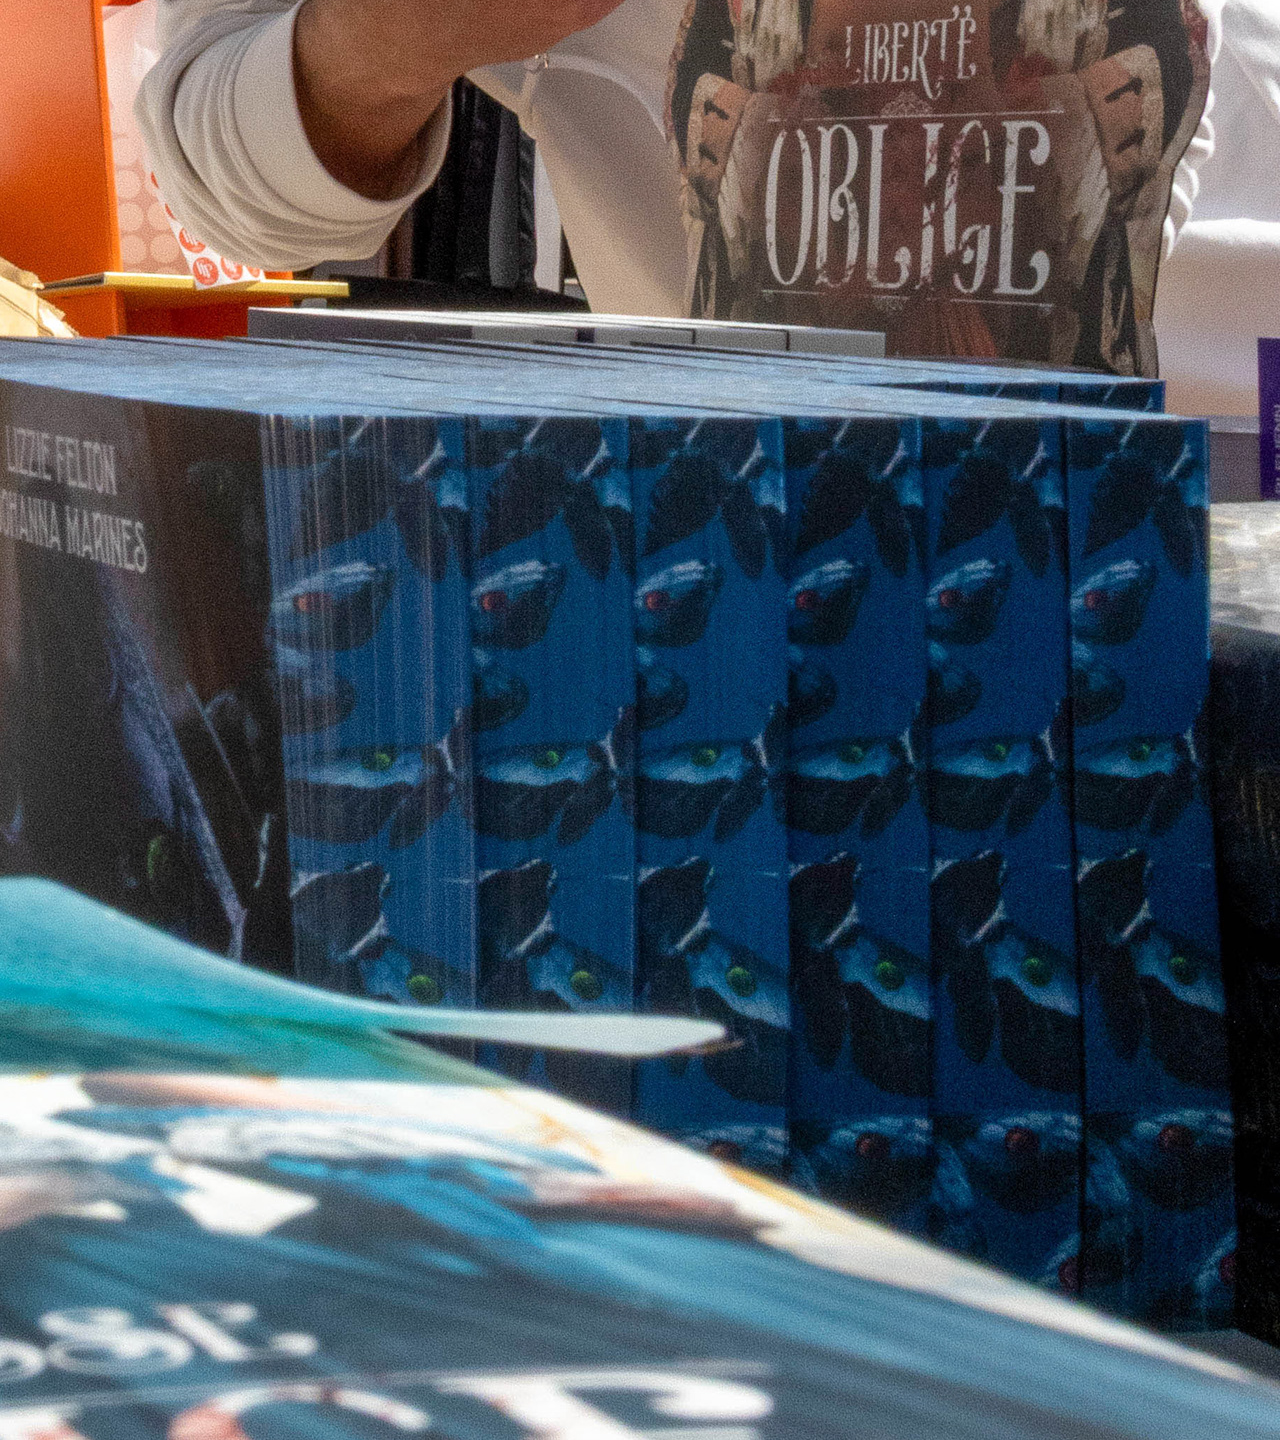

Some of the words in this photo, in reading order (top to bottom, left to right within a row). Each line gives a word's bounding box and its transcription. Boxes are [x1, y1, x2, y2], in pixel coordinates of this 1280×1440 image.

[765, 120, 1051, 295] OBLIGE
[5, 425, 53, 483] LIZZIE
[56, 436, 118, 497] FELTON
[66, 503, 148, 574] MARINES
